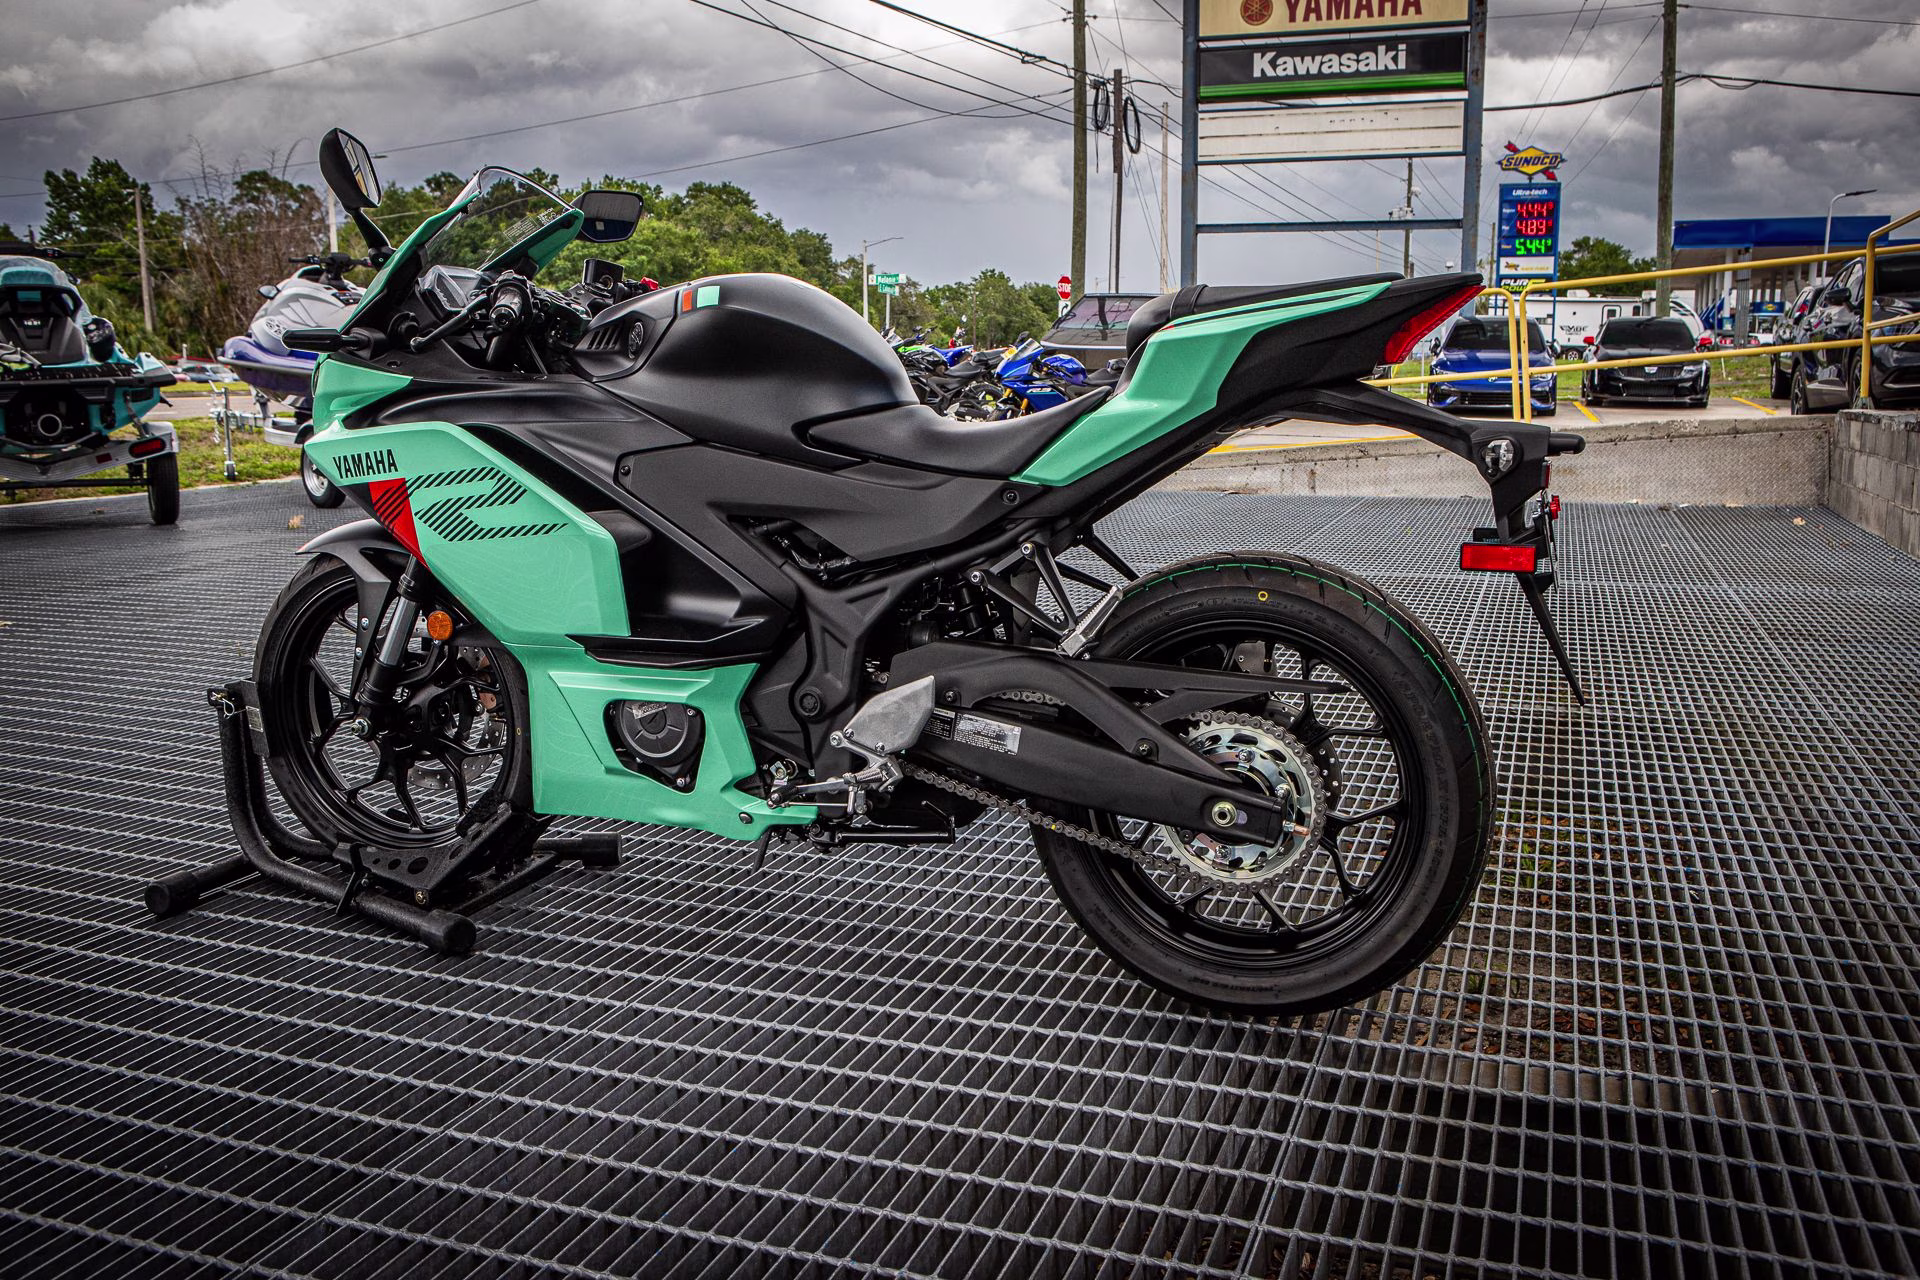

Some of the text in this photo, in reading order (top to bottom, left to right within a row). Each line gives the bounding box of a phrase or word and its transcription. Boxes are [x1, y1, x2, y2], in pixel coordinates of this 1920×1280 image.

[1285, 0, 1423, 23] YAMAHA
[1253, 43, 1407, 78] Kawasaki
[1504, 155, 1560, 167] SUNOCO
[332, 448, 398, 479] YAMAHA
